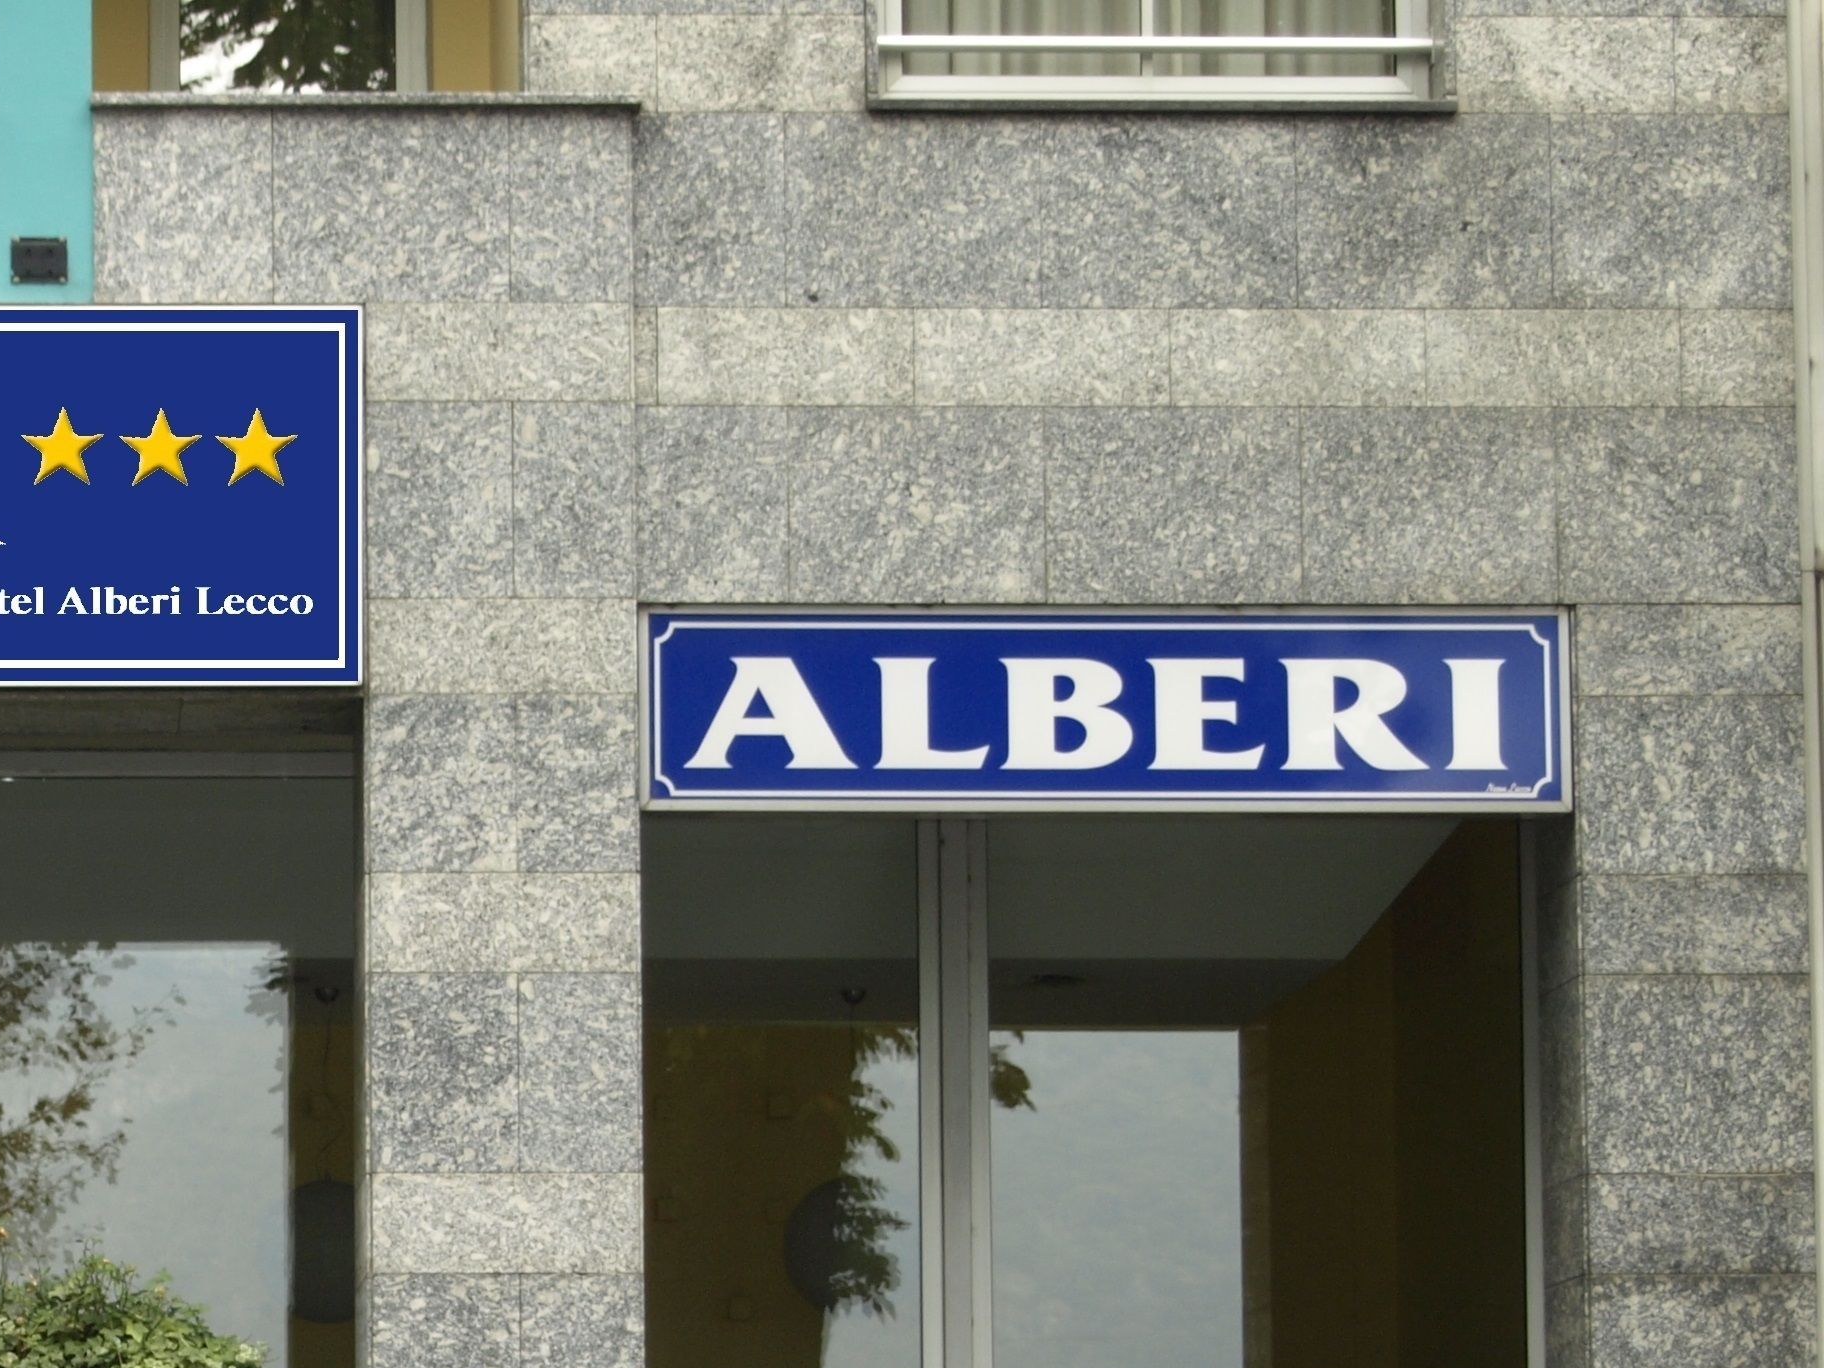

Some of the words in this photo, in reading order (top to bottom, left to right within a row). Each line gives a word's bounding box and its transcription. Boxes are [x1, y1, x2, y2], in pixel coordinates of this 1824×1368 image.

[58, 586, 180, 614] Alberi
[197, 587, 313, 614] Lecco
[684, 657, 1508, 770] ALBERI
